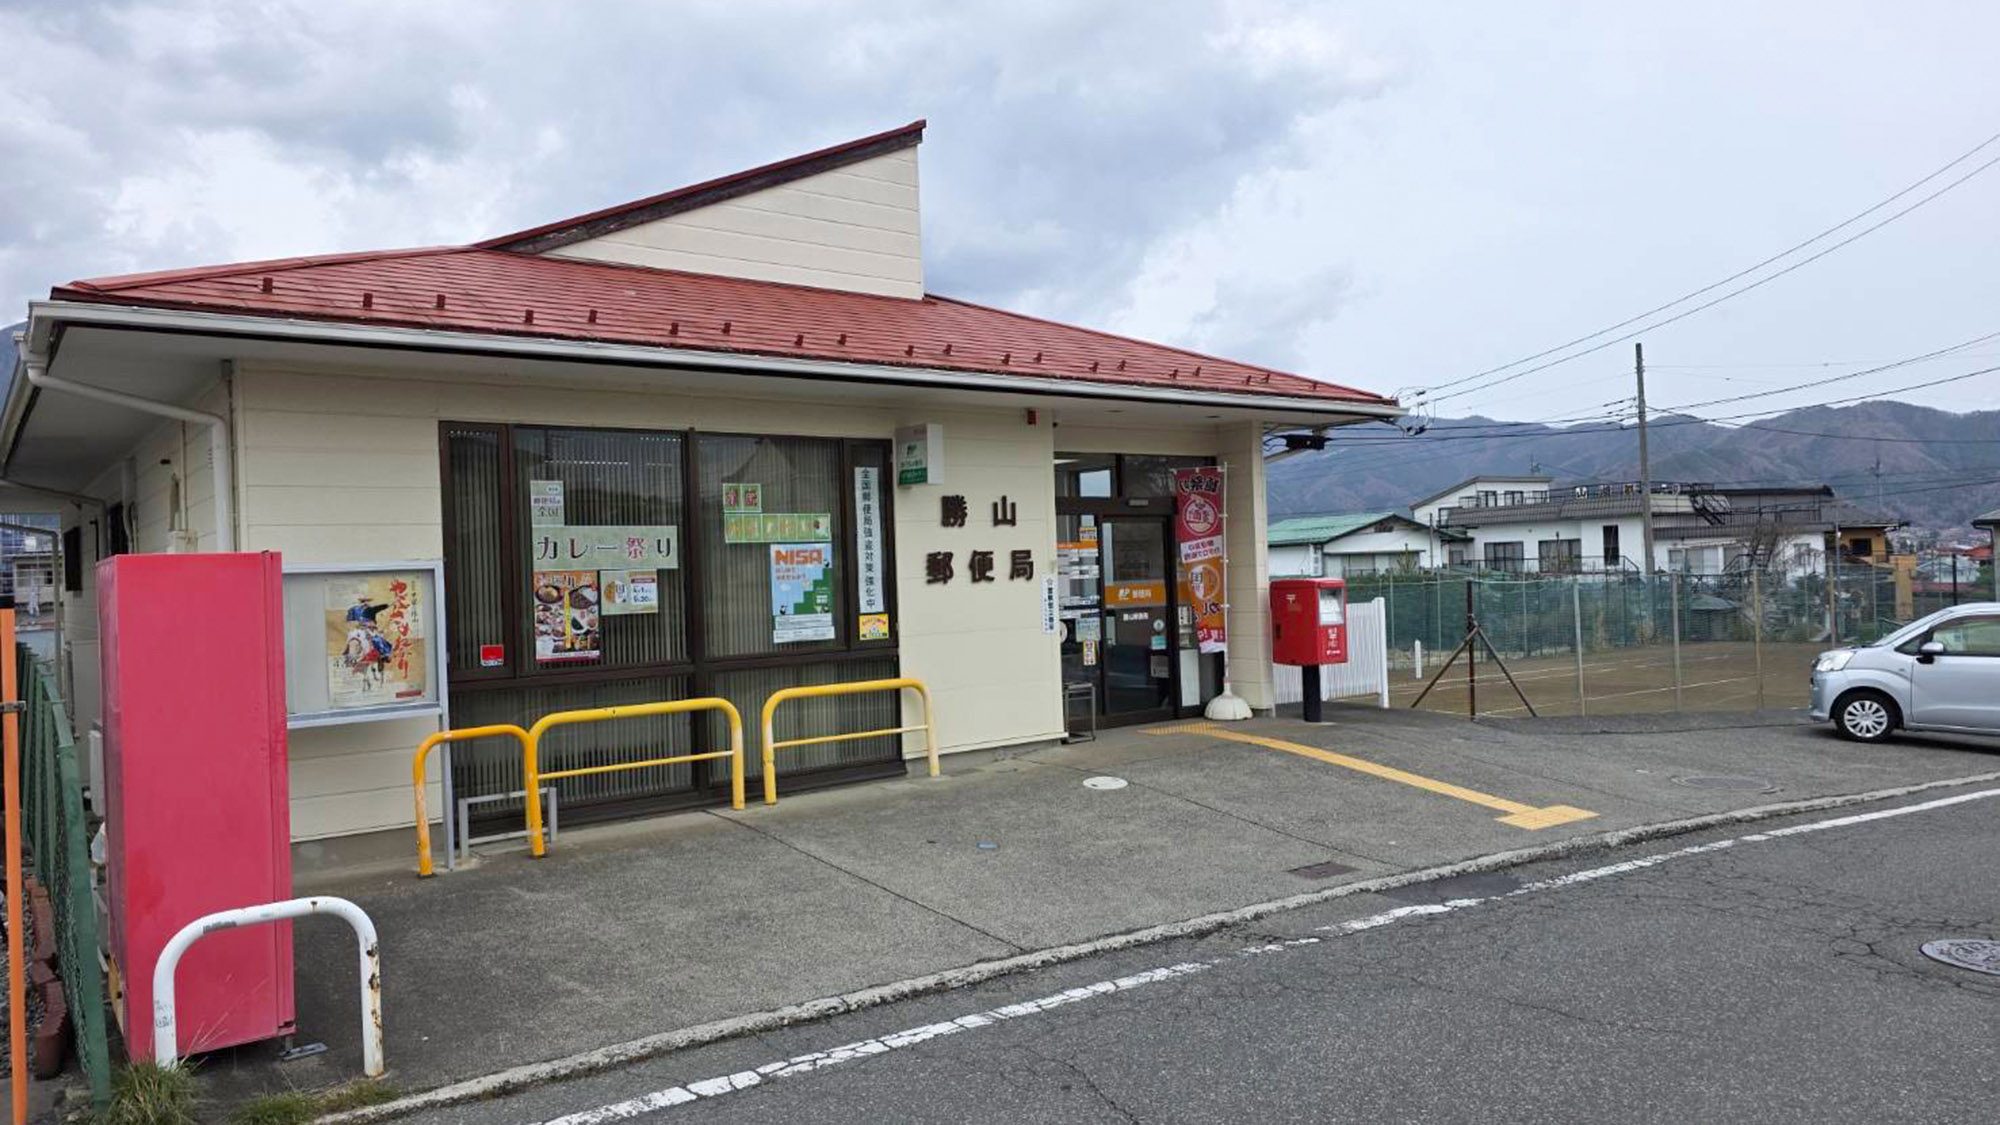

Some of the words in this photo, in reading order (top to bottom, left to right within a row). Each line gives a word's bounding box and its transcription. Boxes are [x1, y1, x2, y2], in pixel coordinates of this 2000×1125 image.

[940, 494, 1017, 528] 勝山
[536, 536, 672, 561] カレー祭り
[775, 549, 824, 565] NISA
[925, 549, 1035, 585] 郵便局
